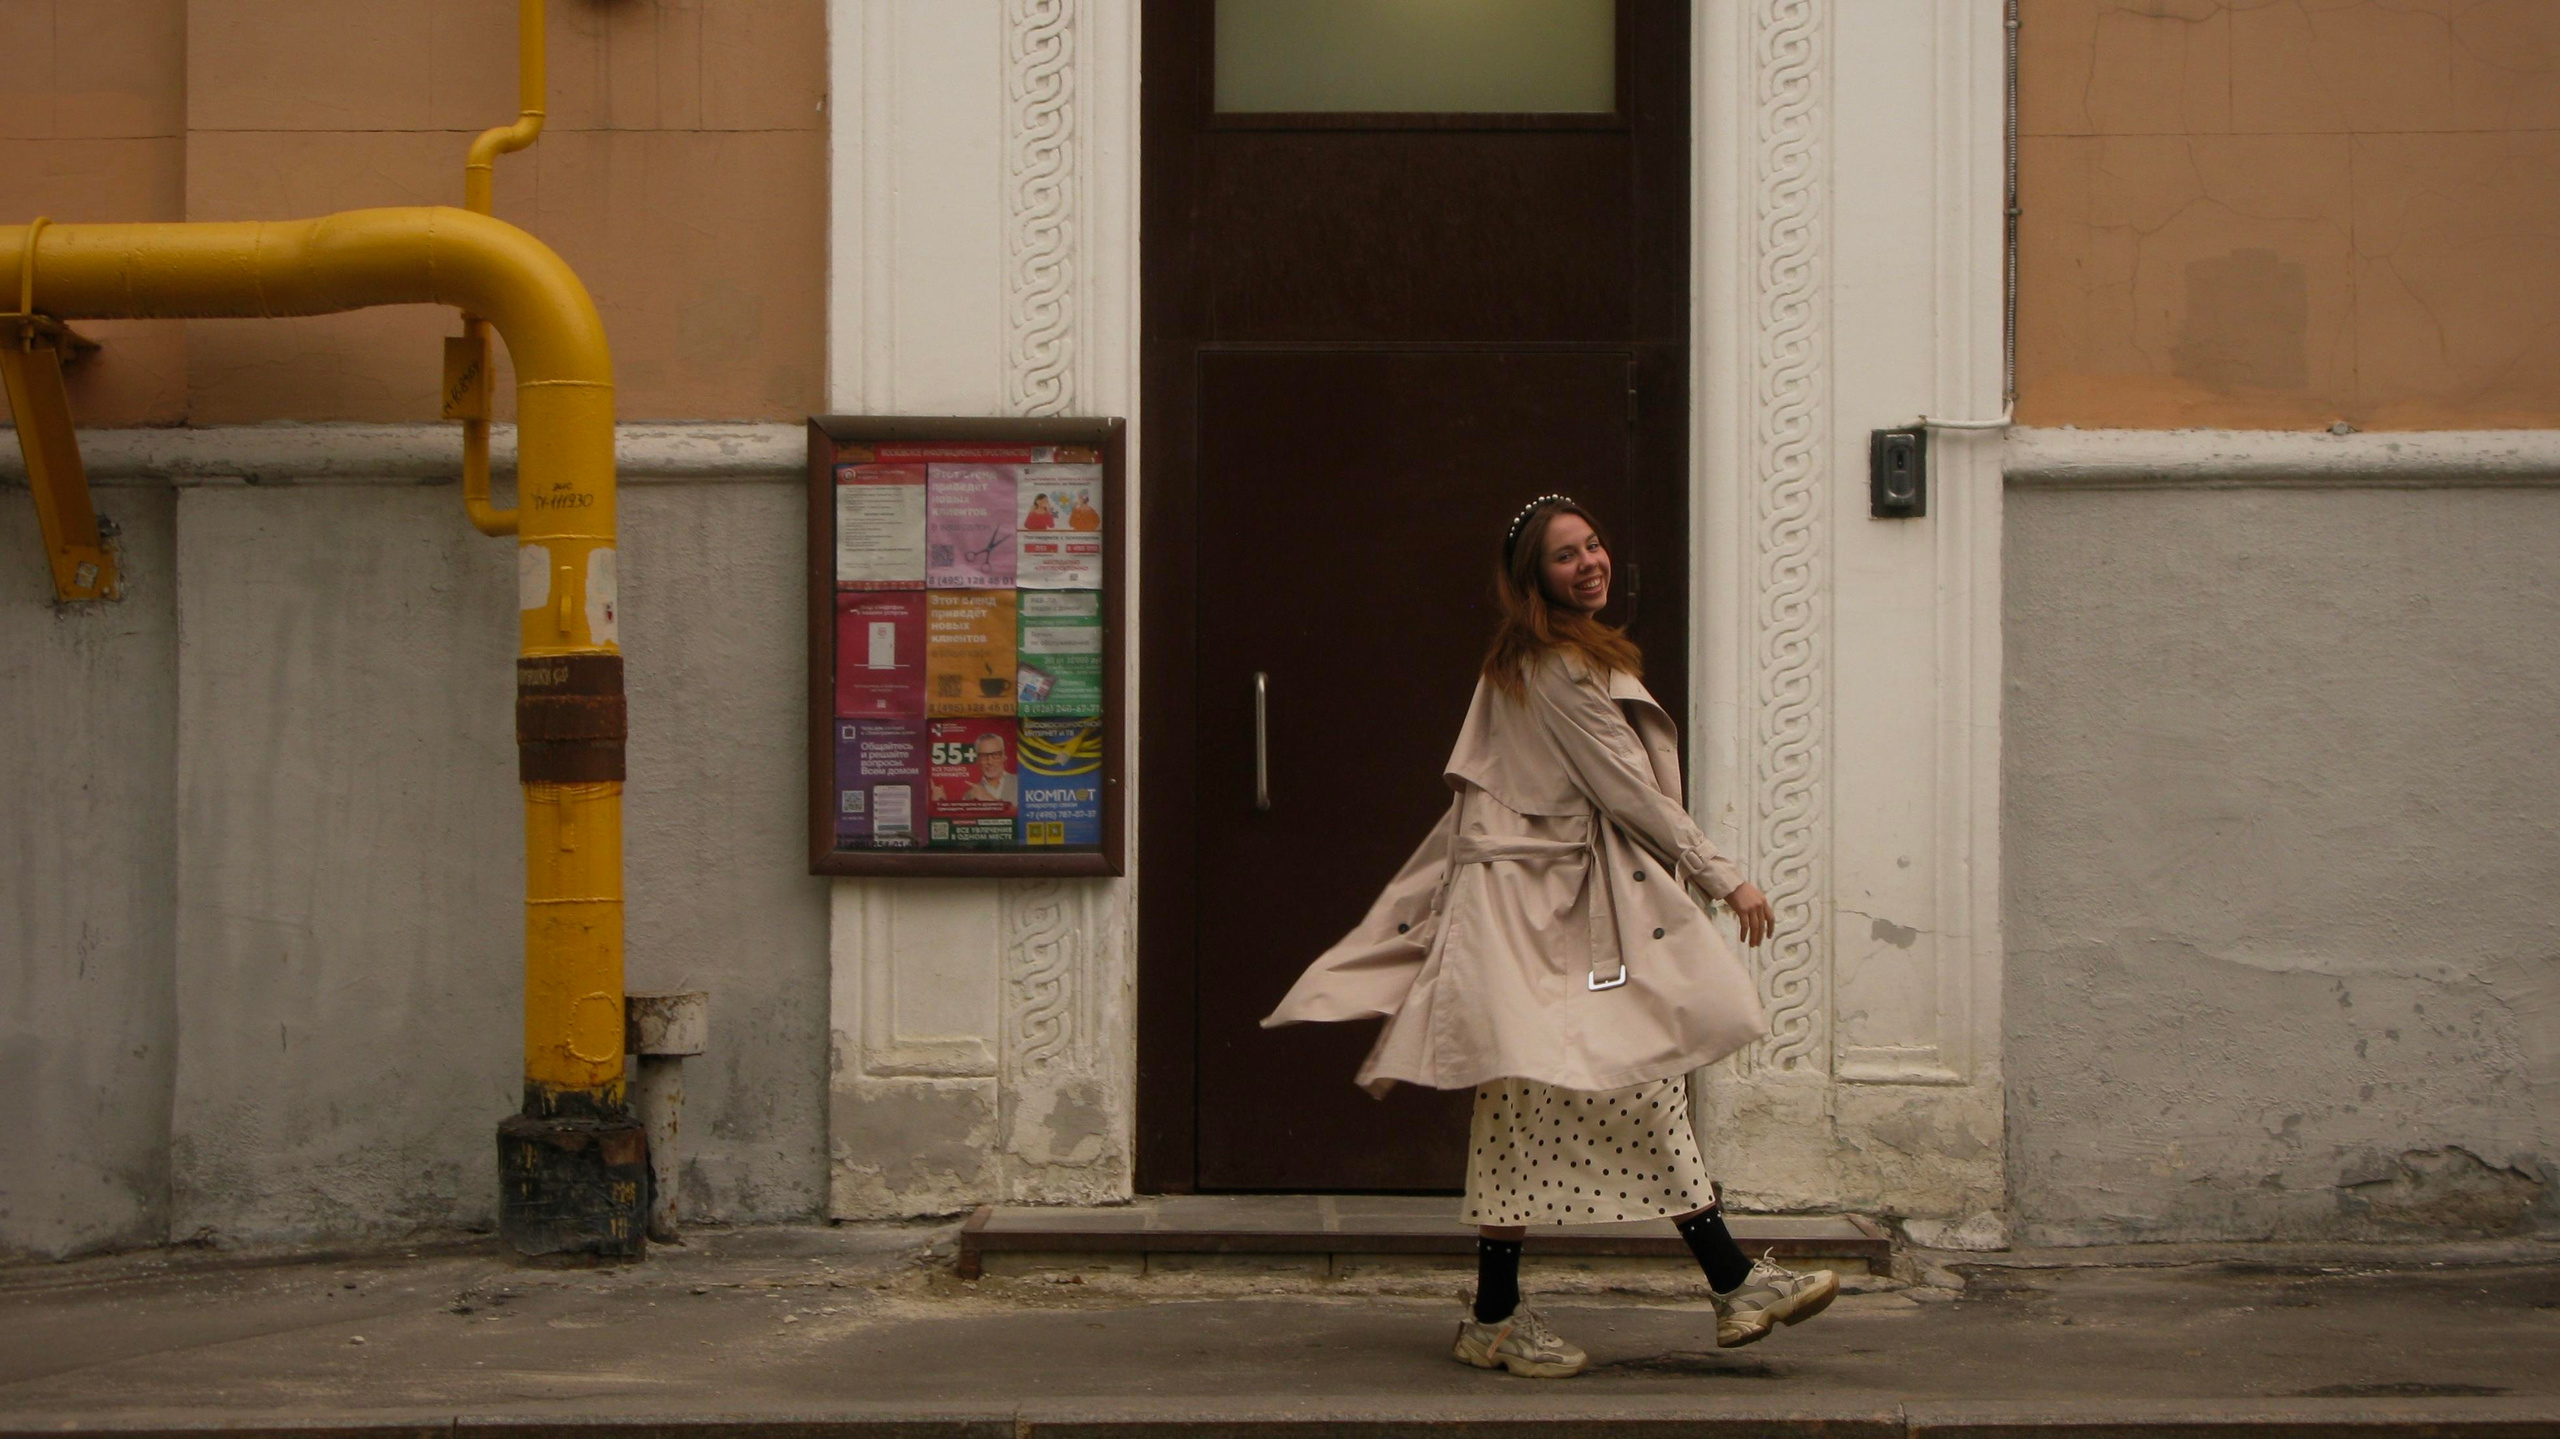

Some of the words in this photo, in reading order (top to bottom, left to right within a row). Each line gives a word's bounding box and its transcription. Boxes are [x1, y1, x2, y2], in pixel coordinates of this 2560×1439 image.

[931, 595, 959, 605] Этот
[931, 622, 970, 631] новых
[931, 634, 988, 643] клиентов
[861, 742, 914, 751] Общайтесь
[869, 751, 909, 760] решайте
[932, 742, 977, 765] 55+
[861, 767, 886, 775] Всем
[887, 768, 919, 776] домом
